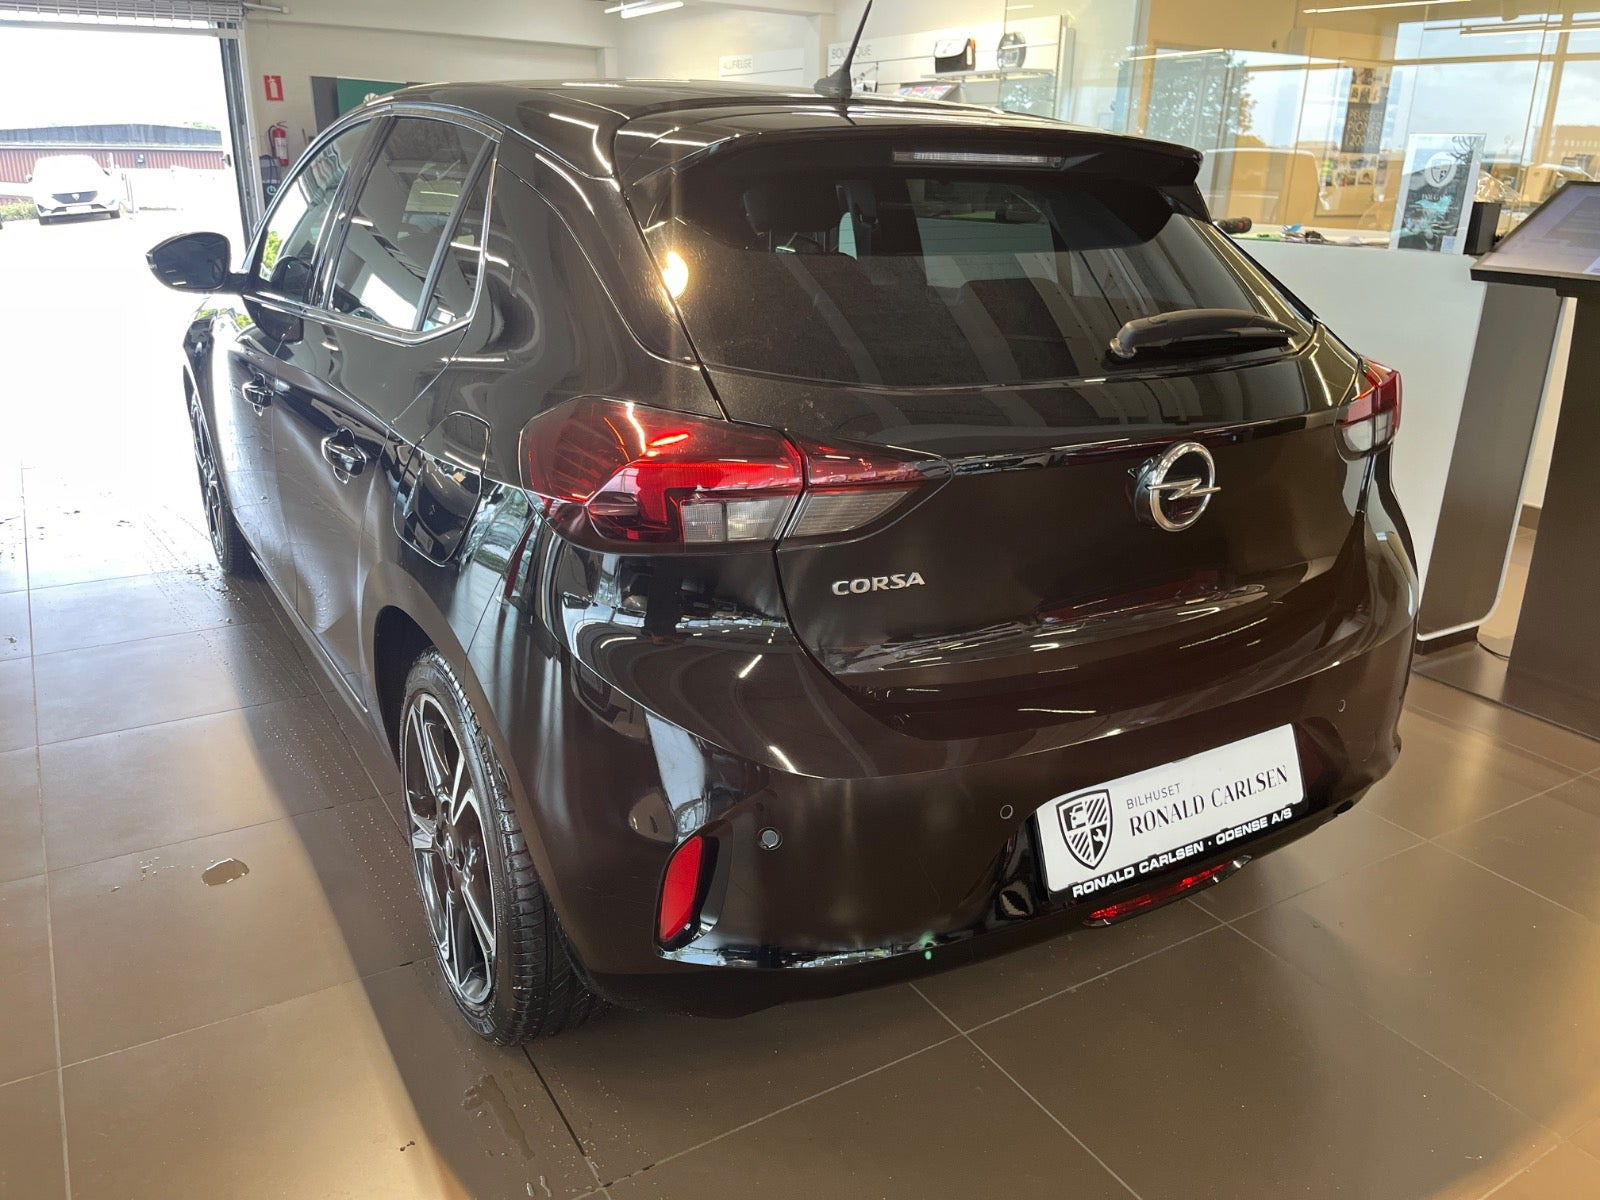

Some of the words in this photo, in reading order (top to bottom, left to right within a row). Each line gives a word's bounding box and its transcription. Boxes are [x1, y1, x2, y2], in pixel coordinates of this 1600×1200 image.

[832, 44, 872, 59] BOUQUE
[832, 572, 925, 596] CORSA
[1126, 782, 1182, 810] BILHUSET
[1129, 795, 1205, 837] RONALD
[1211, 765, 1289, 808] CARLSEN
[1072, 867, 1135, 898] RONALD
[1139, 840, 1204, 874] CARLSEN
[1215, 818, 1269, 846] ODENSE
[1271, 807, 1293, 826] A/S
